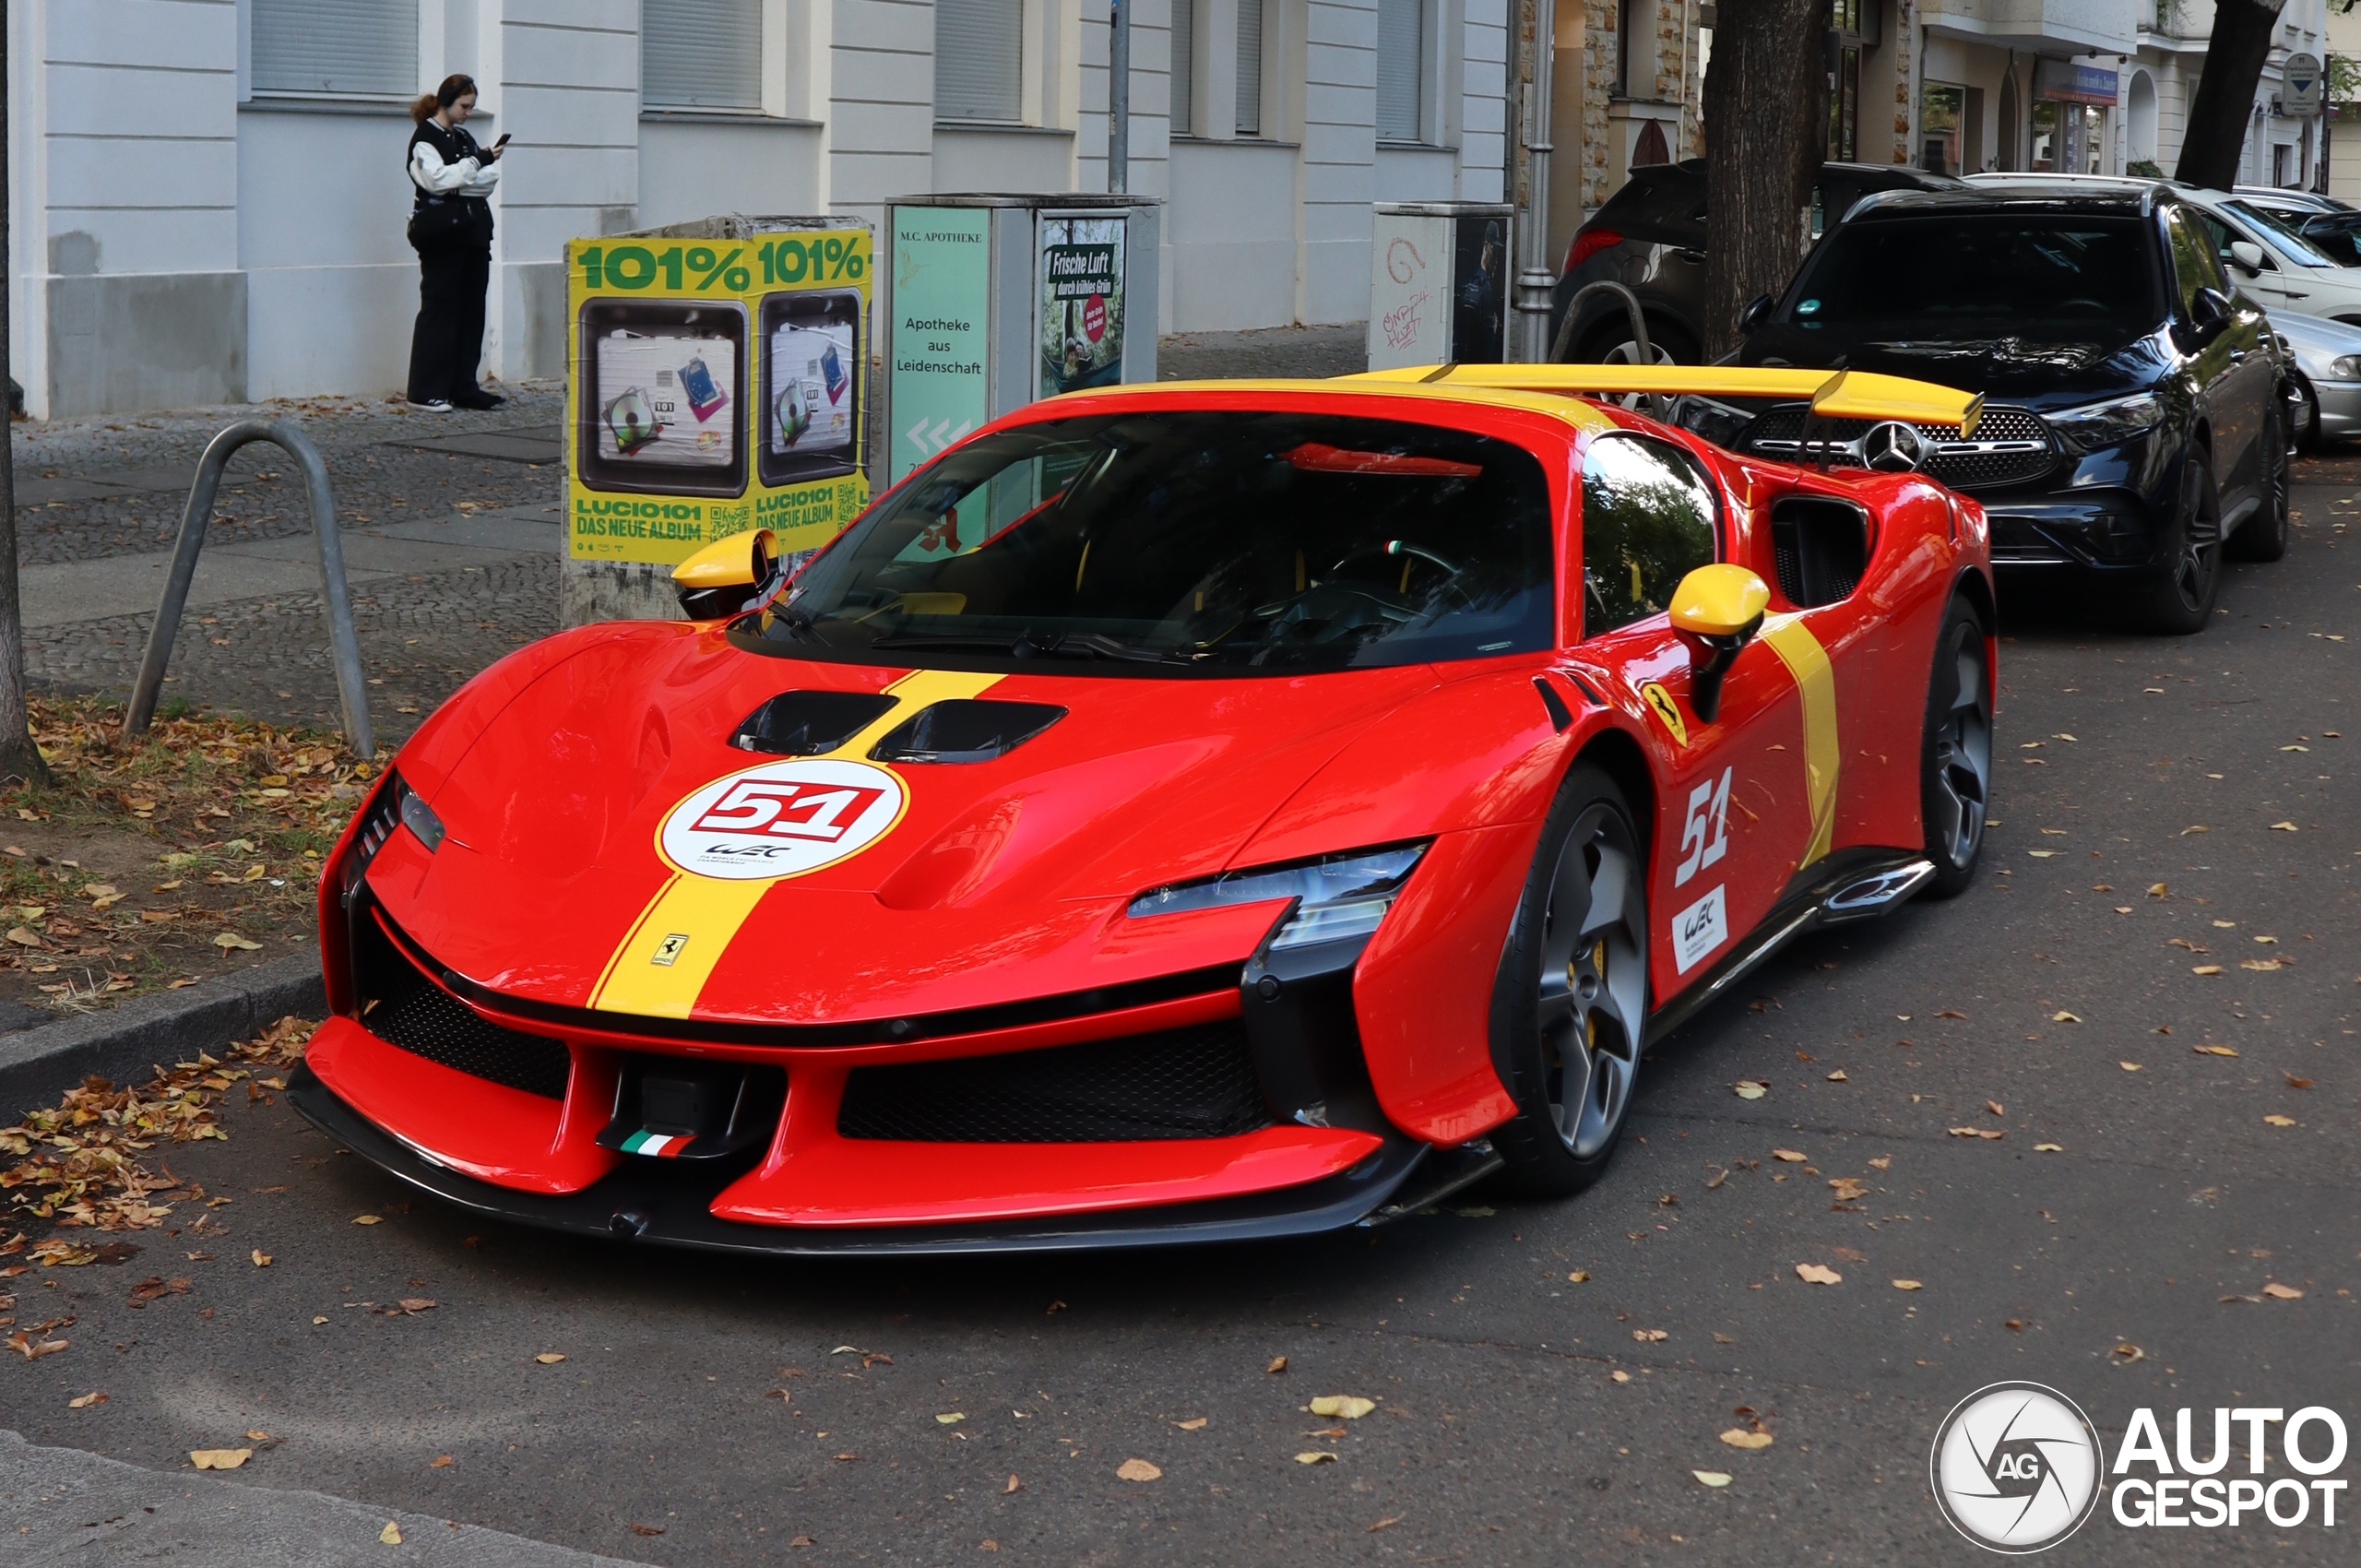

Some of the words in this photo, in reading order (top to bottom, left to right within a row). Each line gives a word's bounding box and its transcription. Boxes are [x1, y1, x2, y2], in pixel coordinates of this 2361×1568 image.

[900, 232, 921, 242] M.C.
[923, 232, 982, 244] APOTHEKE
[577, 246, 751, 291] 101%
[758, 237, 863, 285] 101%
[1052, 251, 1087, 275] Frische
[1087, 251, 1109, 275] Luft
[1057, 280, 1075, 295] durch
[1075, 279, 1096, 295] kühles
[1096, 279, 1111, 293] Grün
[905, 317, 970, 332] Apotheke
[928, 341, 951, 352] aus
[897, 359, 981, 374] Leidenschaft
[808, 390, 818, 398] 101
[656, 403, 673, 411] 101
[576, 499, 701, 520] LUCIO101
[756, 487, 833, 513] LUCIO101
[576, 517, 606, 536] DAS
[609, 518, 647, 539] NEUE
[648, 521, 701, 541] ALBUM
[756, 514, 776, 531] DAS
[777, 509, 801, 530] NEUE
[801, 505, 833, 526] ALBUM
[696, 782, 860, 839] 51
[1675, 766, 1733, 888] 51
[705, 843, 792, 859] WEC
[1685, 898, 1714, 942] WEC
